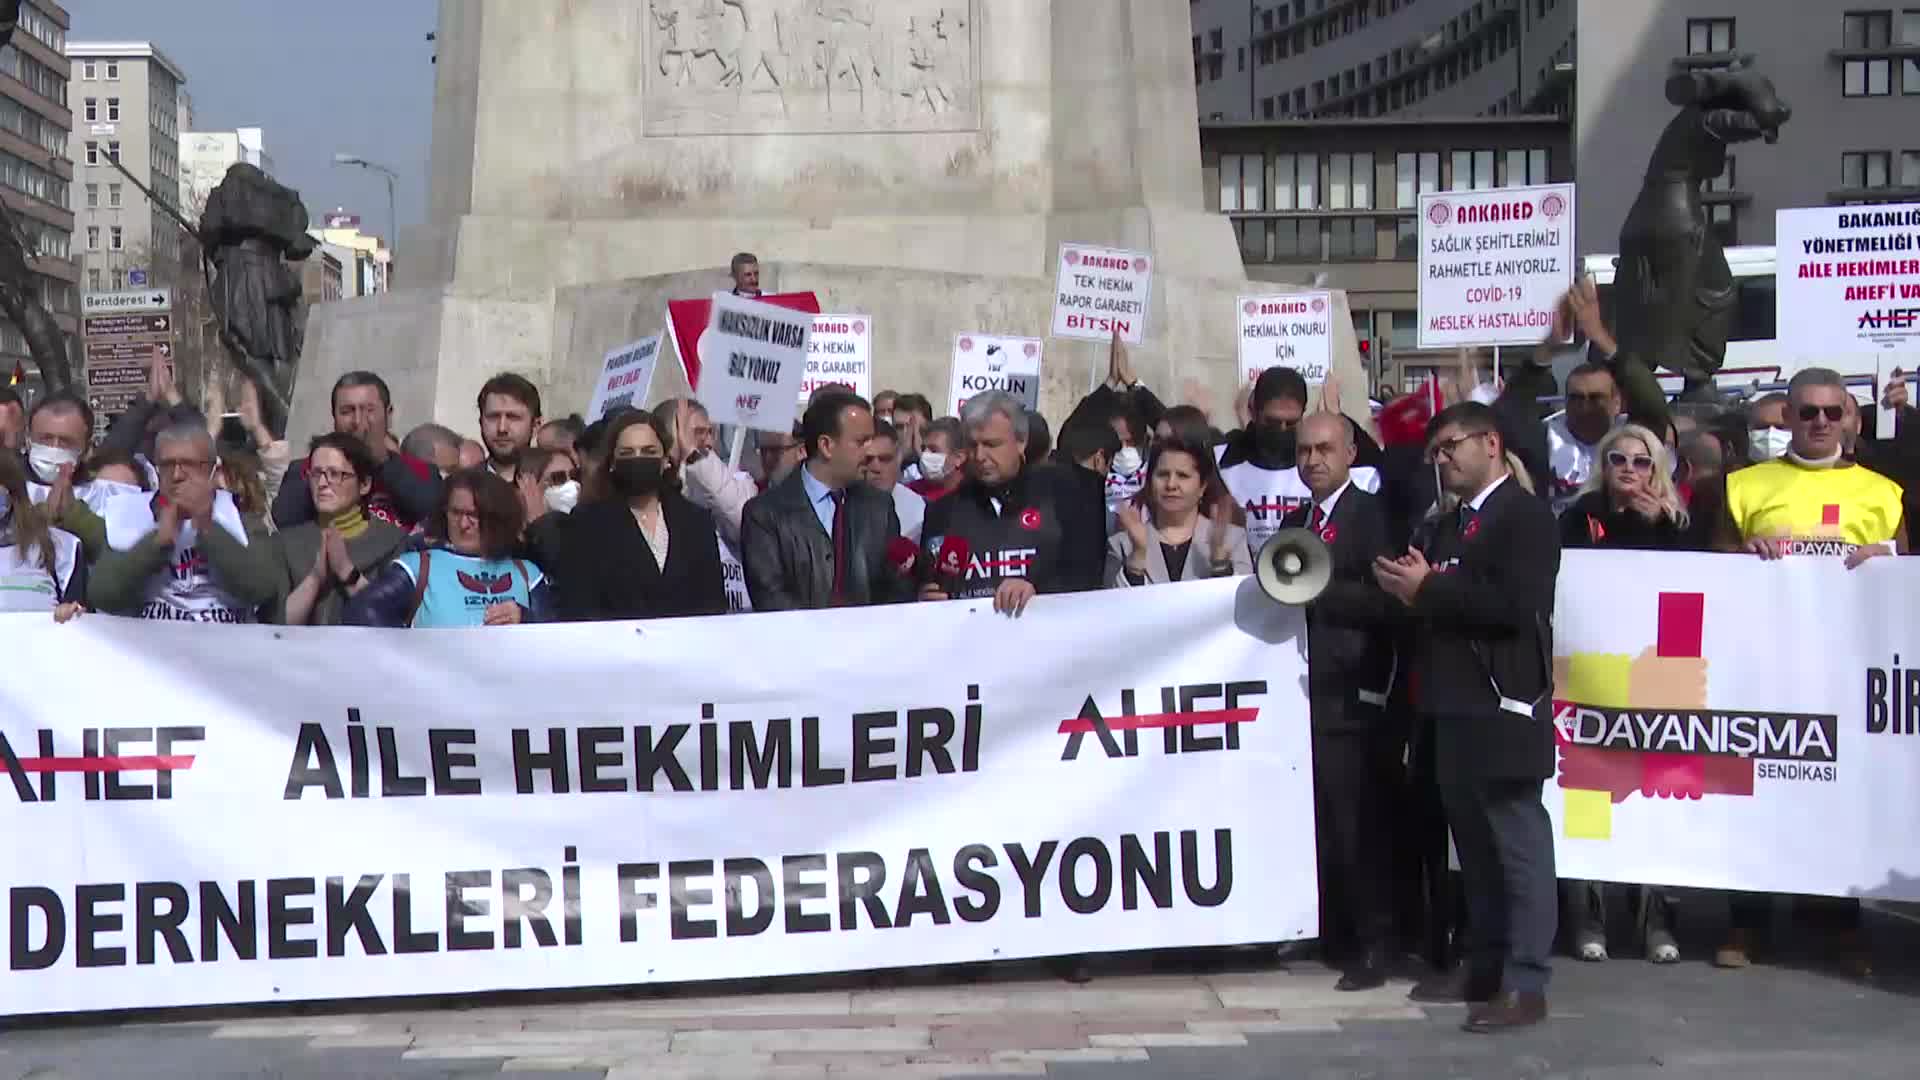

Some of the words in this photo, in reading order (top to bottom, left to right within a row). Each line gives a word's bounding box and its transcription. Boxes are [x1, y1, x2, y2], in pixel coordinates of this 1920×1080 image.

[1457, 201, 1534, 224] ANKAHED
[1838, 208, 1920, 228] BAKANLIĞ
[1431, 234, 1472, 253] SAĞLIK
[1476, 227, 1561, 254] ŞEHİTLERİMİZİ
[1802, 233, 1912, 254] YÖNETMELİĞİ
[1429, 261, 1492, 279] RAHMETLE
[1495, 257, 1561, 276] ANIYORUZ.
[1798, 260, 1832, 279] AİLE
[1837, 258, 1920, 278] HEKİMLER
[1074, 274, 1096, 288] TEK
[1098, 276, 1133, 292] HEKİM
[1466, 283, 1522, 303] COVİD-19
[1844, 282, 1896, 301] AHEF'İ
[1900, 284, 1920, 299] VA
[1060, 293, 1092, 308] RAPOR
[1066, 314, 1130, 333] BİTSİN
[1429, 311, 1475, 331] MESLEK
[1858, 308, 1920, 329] AHEF
[771, 319, 806, 349] VARSA
[1243, 322, 1289, 338] HEKİMLİK
[1291, 321, 1326, 336] ONURU
[806, 342, 820, 353] EK
[823, 340, 856, 354] HEKİM
[1275, 341, 1295, 360] İÇİN
[749, 358, 782, 385] YOKUZ
[962, 375, 1026, 393] KOYUN
[964, 548, 1037, 581] AHEF
[284, 707, 481, 800] AİLE
[511, 684, 983, 794] HEKİMLERİ
[1057, 680, 1268, 760] AHEF
[1758, 759, 1837, 782] SENDİKASI
[9, 846, 583, 971] DERNEKLERİ
[617, 827, 1234, 943] FEDERASYONU
